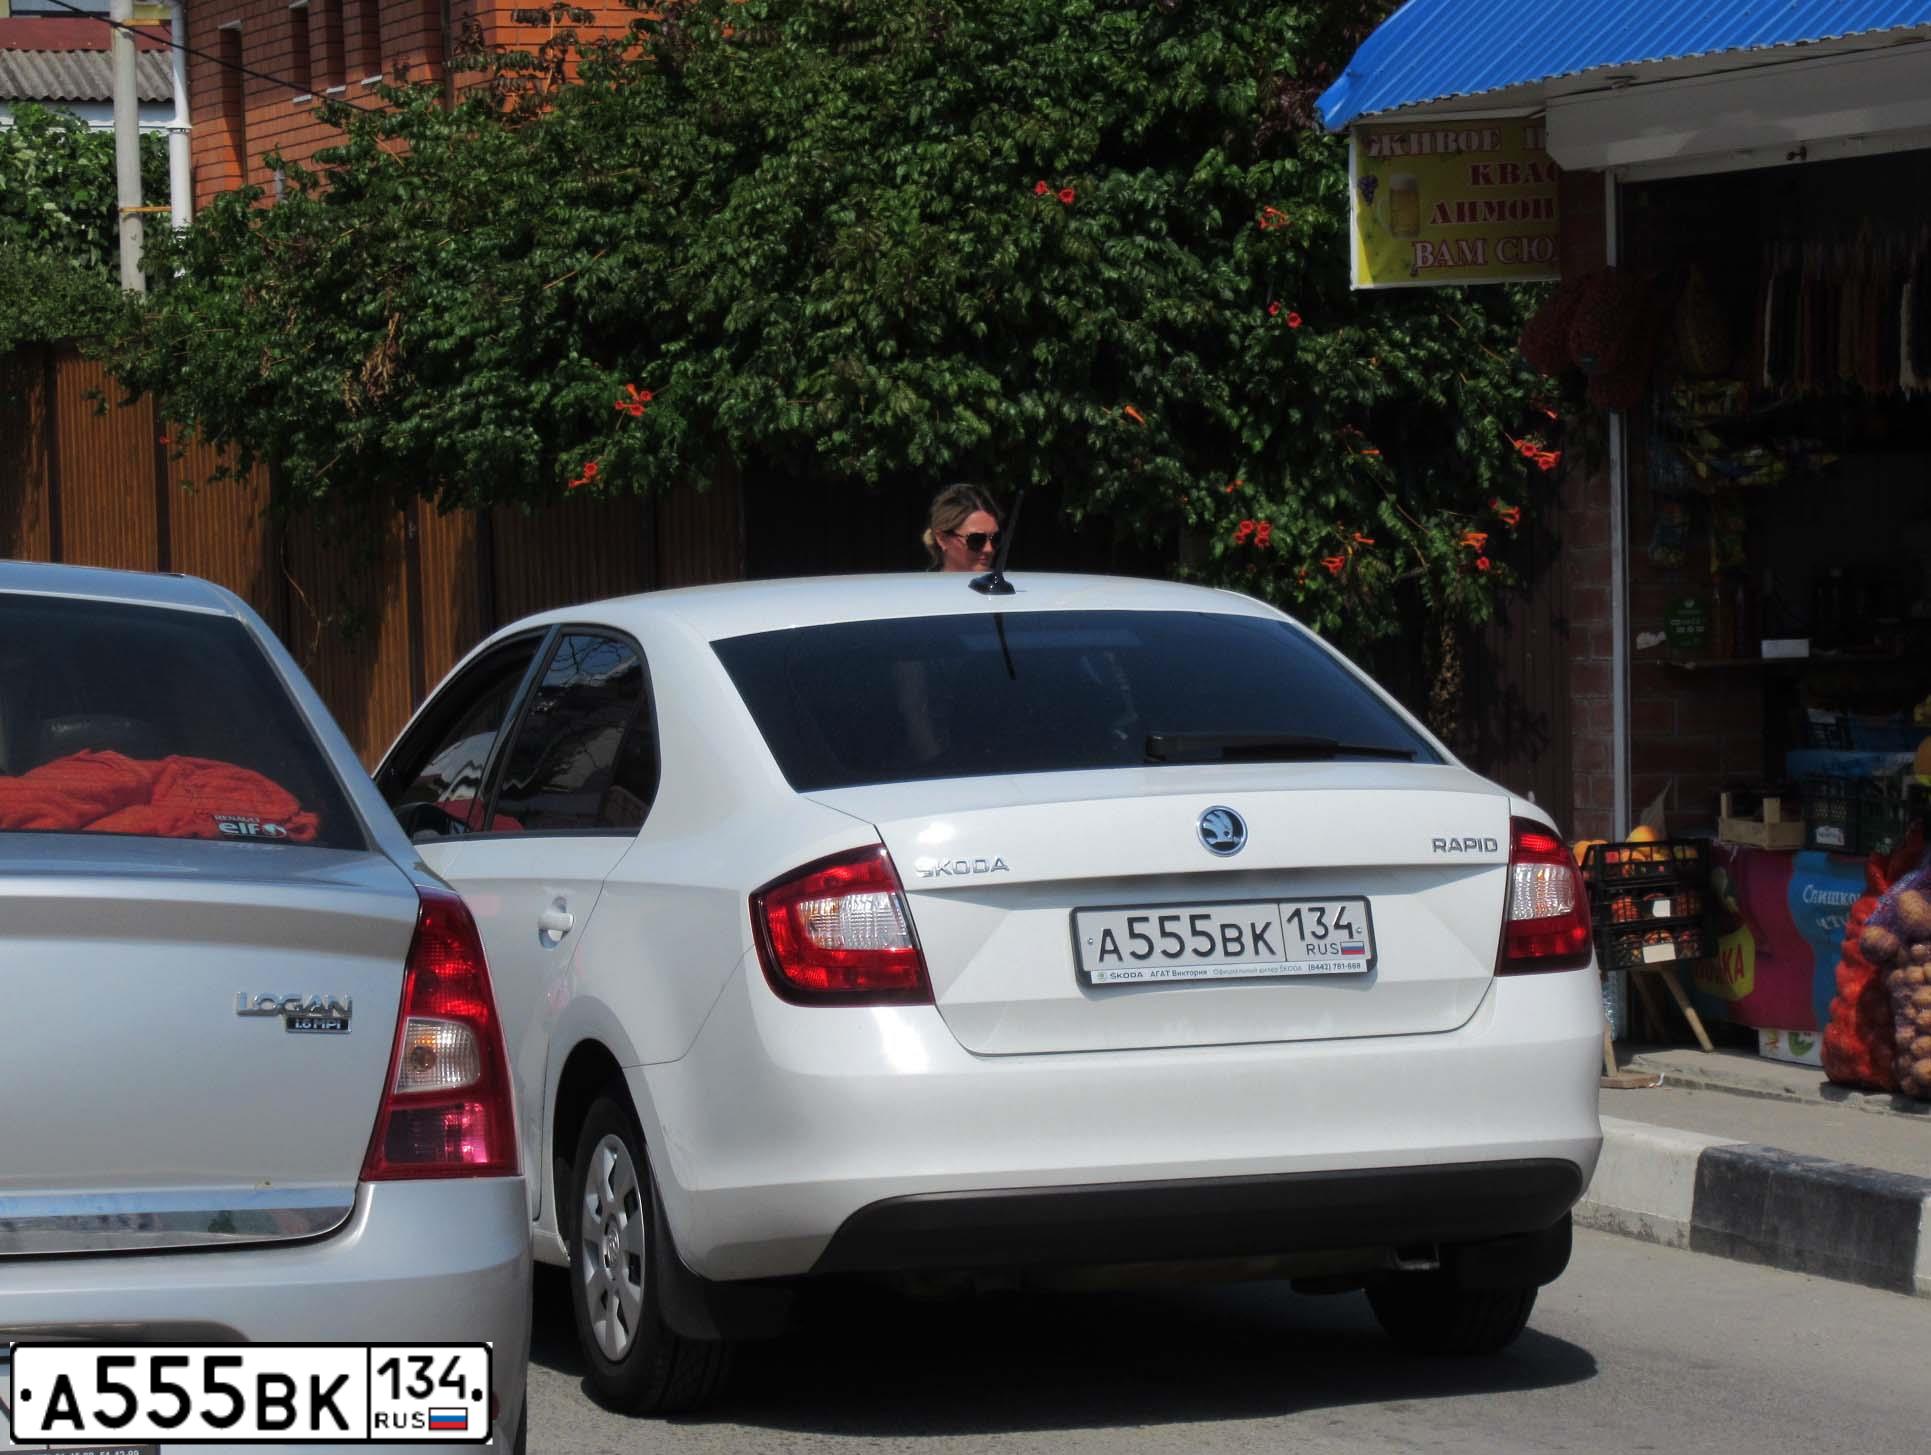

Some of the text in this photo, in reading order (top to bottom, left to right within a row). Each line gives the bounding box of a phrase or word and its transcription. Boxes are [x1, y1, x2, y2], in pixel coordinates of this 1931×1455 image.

[1362, 128, 1502, 158] ЖИВОЕ
[1414, 238, 1488, 267] ВАМ
[1431, 837, 1498, 853] RAPID
[1098, 906, 1354, 963] А555ВК 134
[1306, 942, 1340, 956] RUS
[237, 991, 352, 1017] LOGAN
